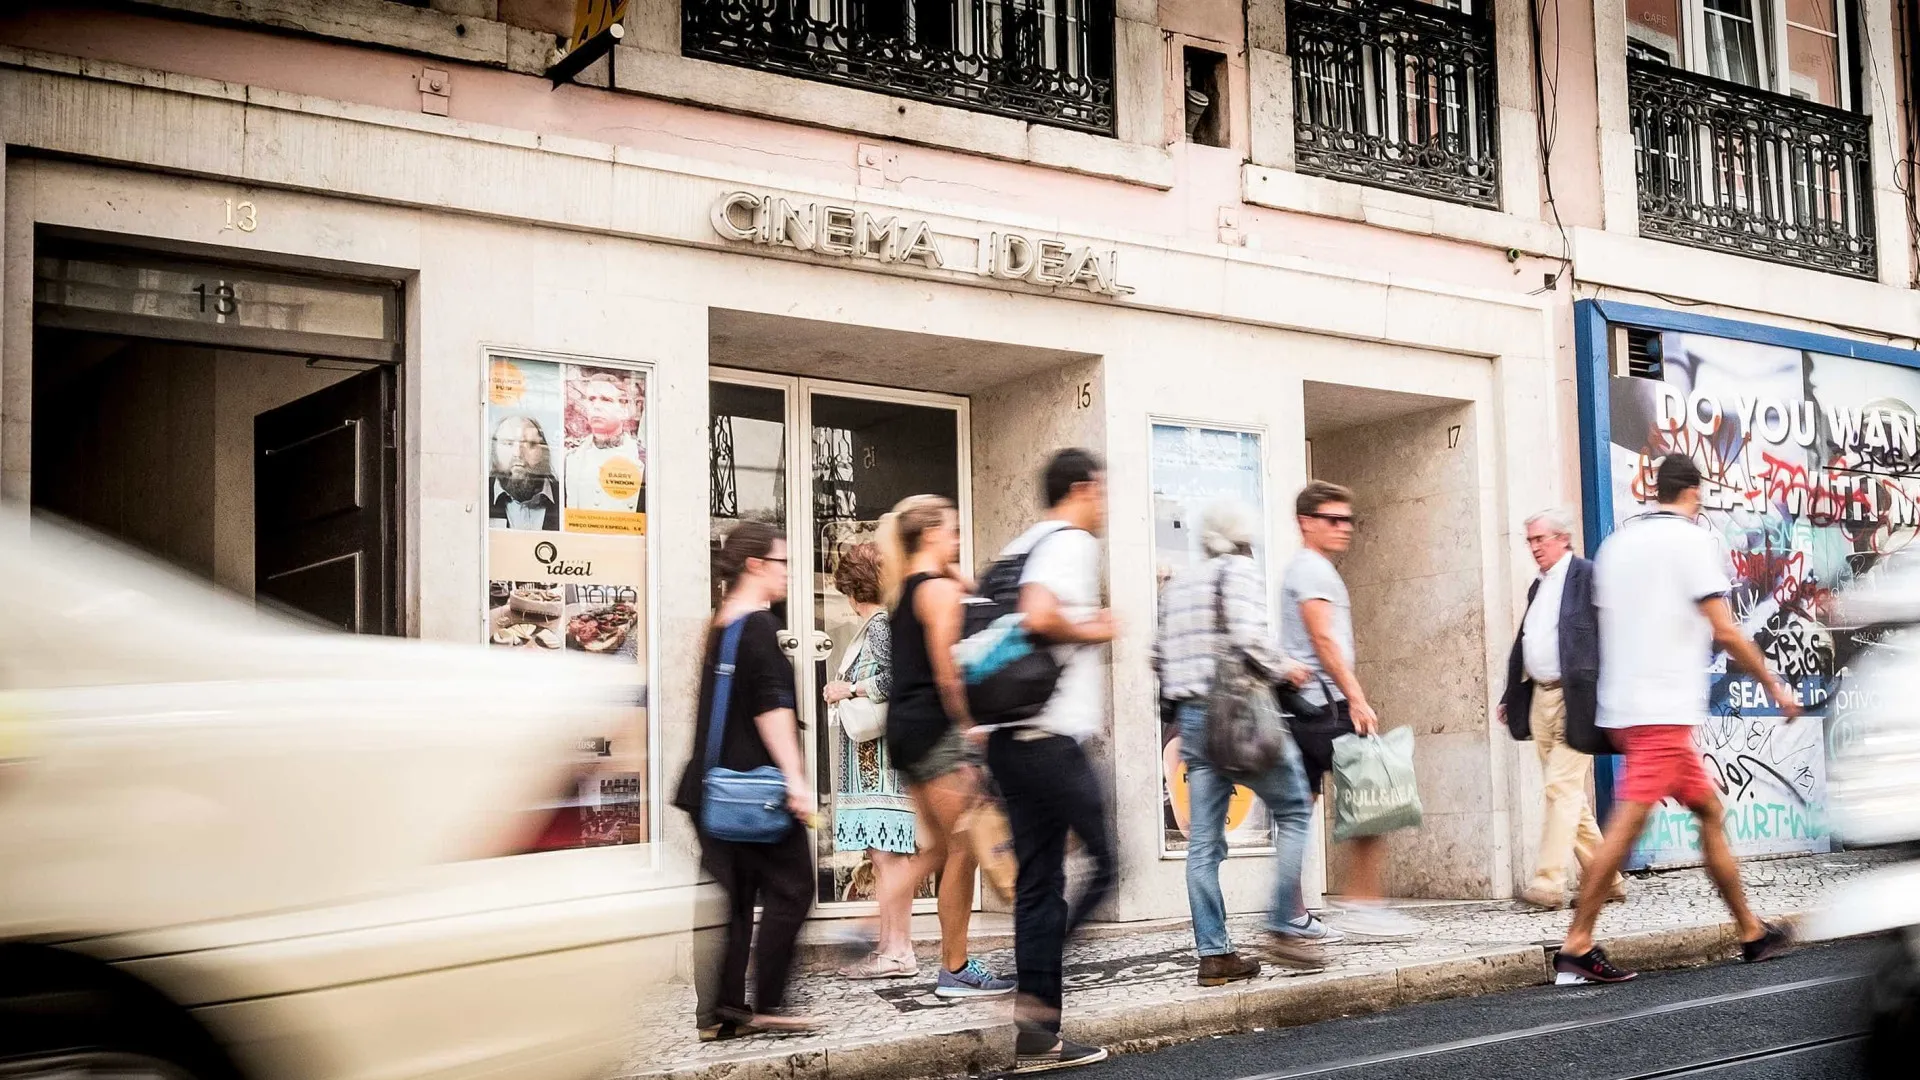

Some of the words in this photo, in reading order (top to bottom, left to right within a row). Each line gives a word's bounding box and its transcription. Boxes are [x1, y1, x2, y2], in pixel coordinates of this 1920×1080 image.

[223, 198, 258, 232] 13
[711, 190, 944, 268] CINEMA
[978, 230, 1137, 297] IDEAL
[192, 283, 236, 315] 13
[1076, 382, 1091, 410] 15
[1655, 381, 1723, 437] DO
[1733, 392, 1817, 448] YOU
[1826, 402, 1920, 459] WAN
[1446, 424, 1462, 449] 17
[1702, 456, 1773, 513] EAT
[1783, 467, 1879, 522] WITH
[546, 560, 593, 577] ideal
[1728, 681, 1769, 709] SEA
